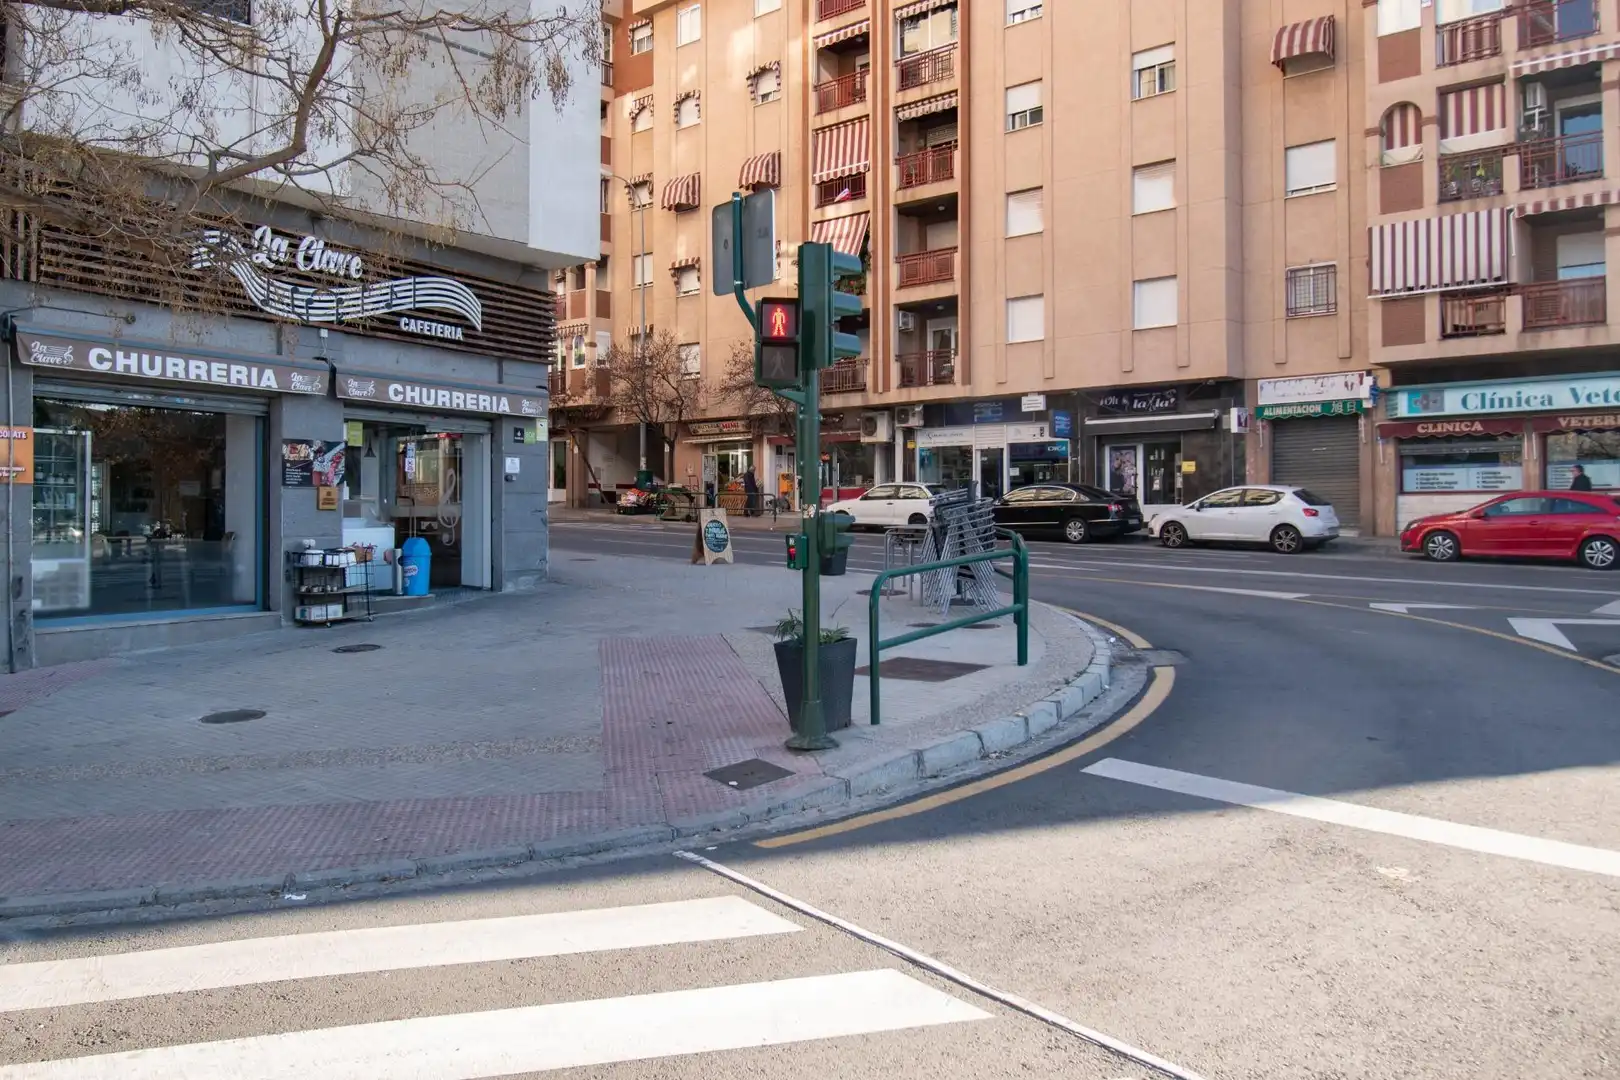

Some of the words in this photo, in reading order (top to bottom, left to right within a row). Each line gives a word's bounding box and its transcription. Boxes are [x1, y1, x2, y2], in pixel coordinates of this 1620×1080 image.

[251, 225, 289, 268] La
[296, 236, 362, 278] Clave
[399, 316, 464, 341] CAFETERIA
[31, 341, 47, 353] La
[30, 352, 62, 365] Clave
[88, 347, 279, 389] CHURRERIA
[388, 383, 511, 413] CHURRERIA
[1263, 403, 1321, 416] ALIMENTACION
[1331, 401, 1356, 413] 旭日
[1460, 389, 1553, 411] Clínica
[1416, 420, 1484, 433] CLINICA
